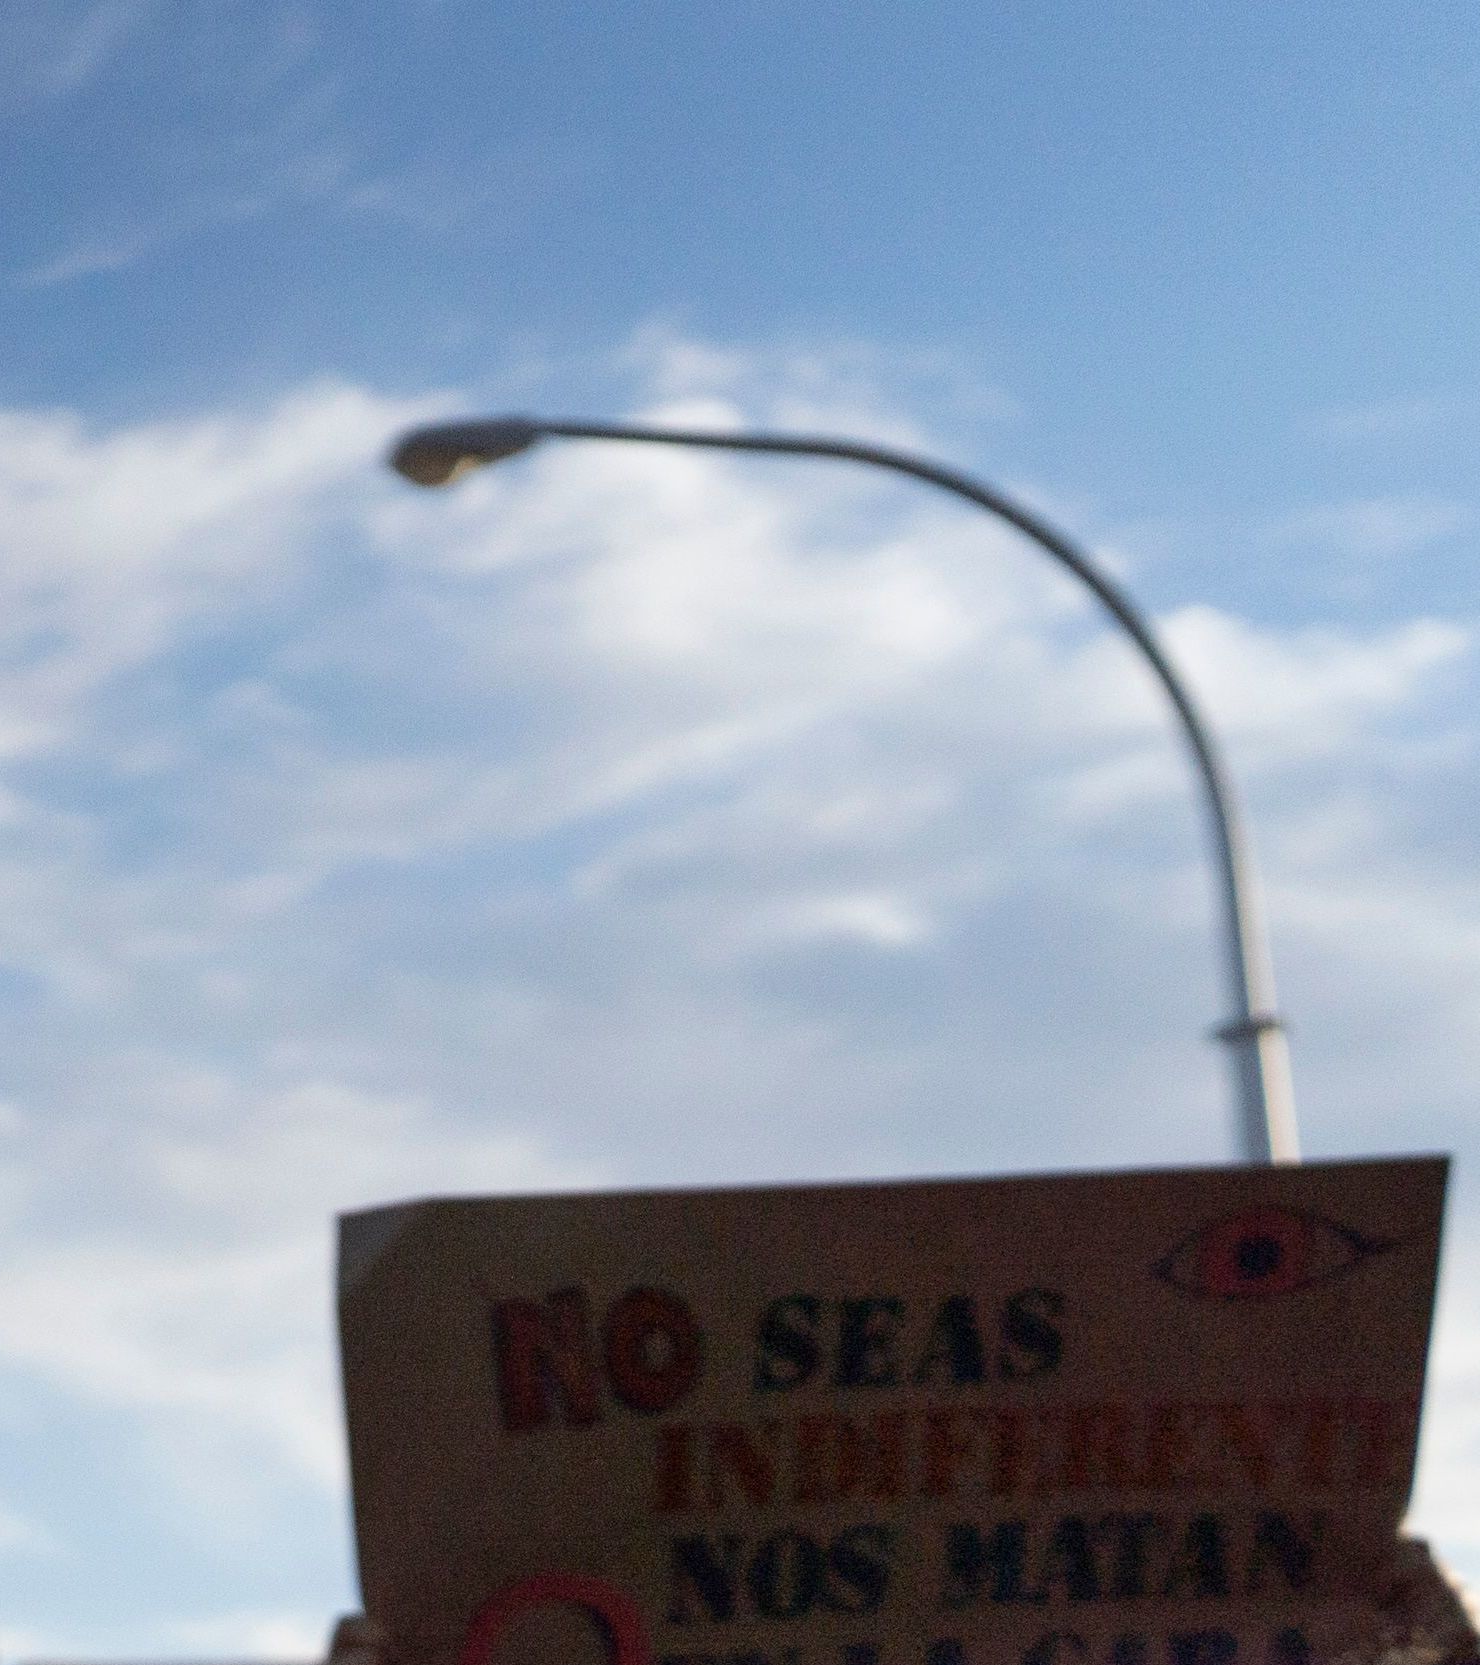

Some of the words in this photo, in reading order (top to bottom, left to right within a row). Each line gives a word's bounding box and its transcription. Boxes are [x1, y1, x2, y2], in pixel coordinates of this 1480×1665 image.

[493, 1283, 703, 1436] NO
[753, 1288, 1066, 1393] SEAS
[667, 1522, 901, 1627] NOS
[942, 1508, 1328, 1608] MATAN
